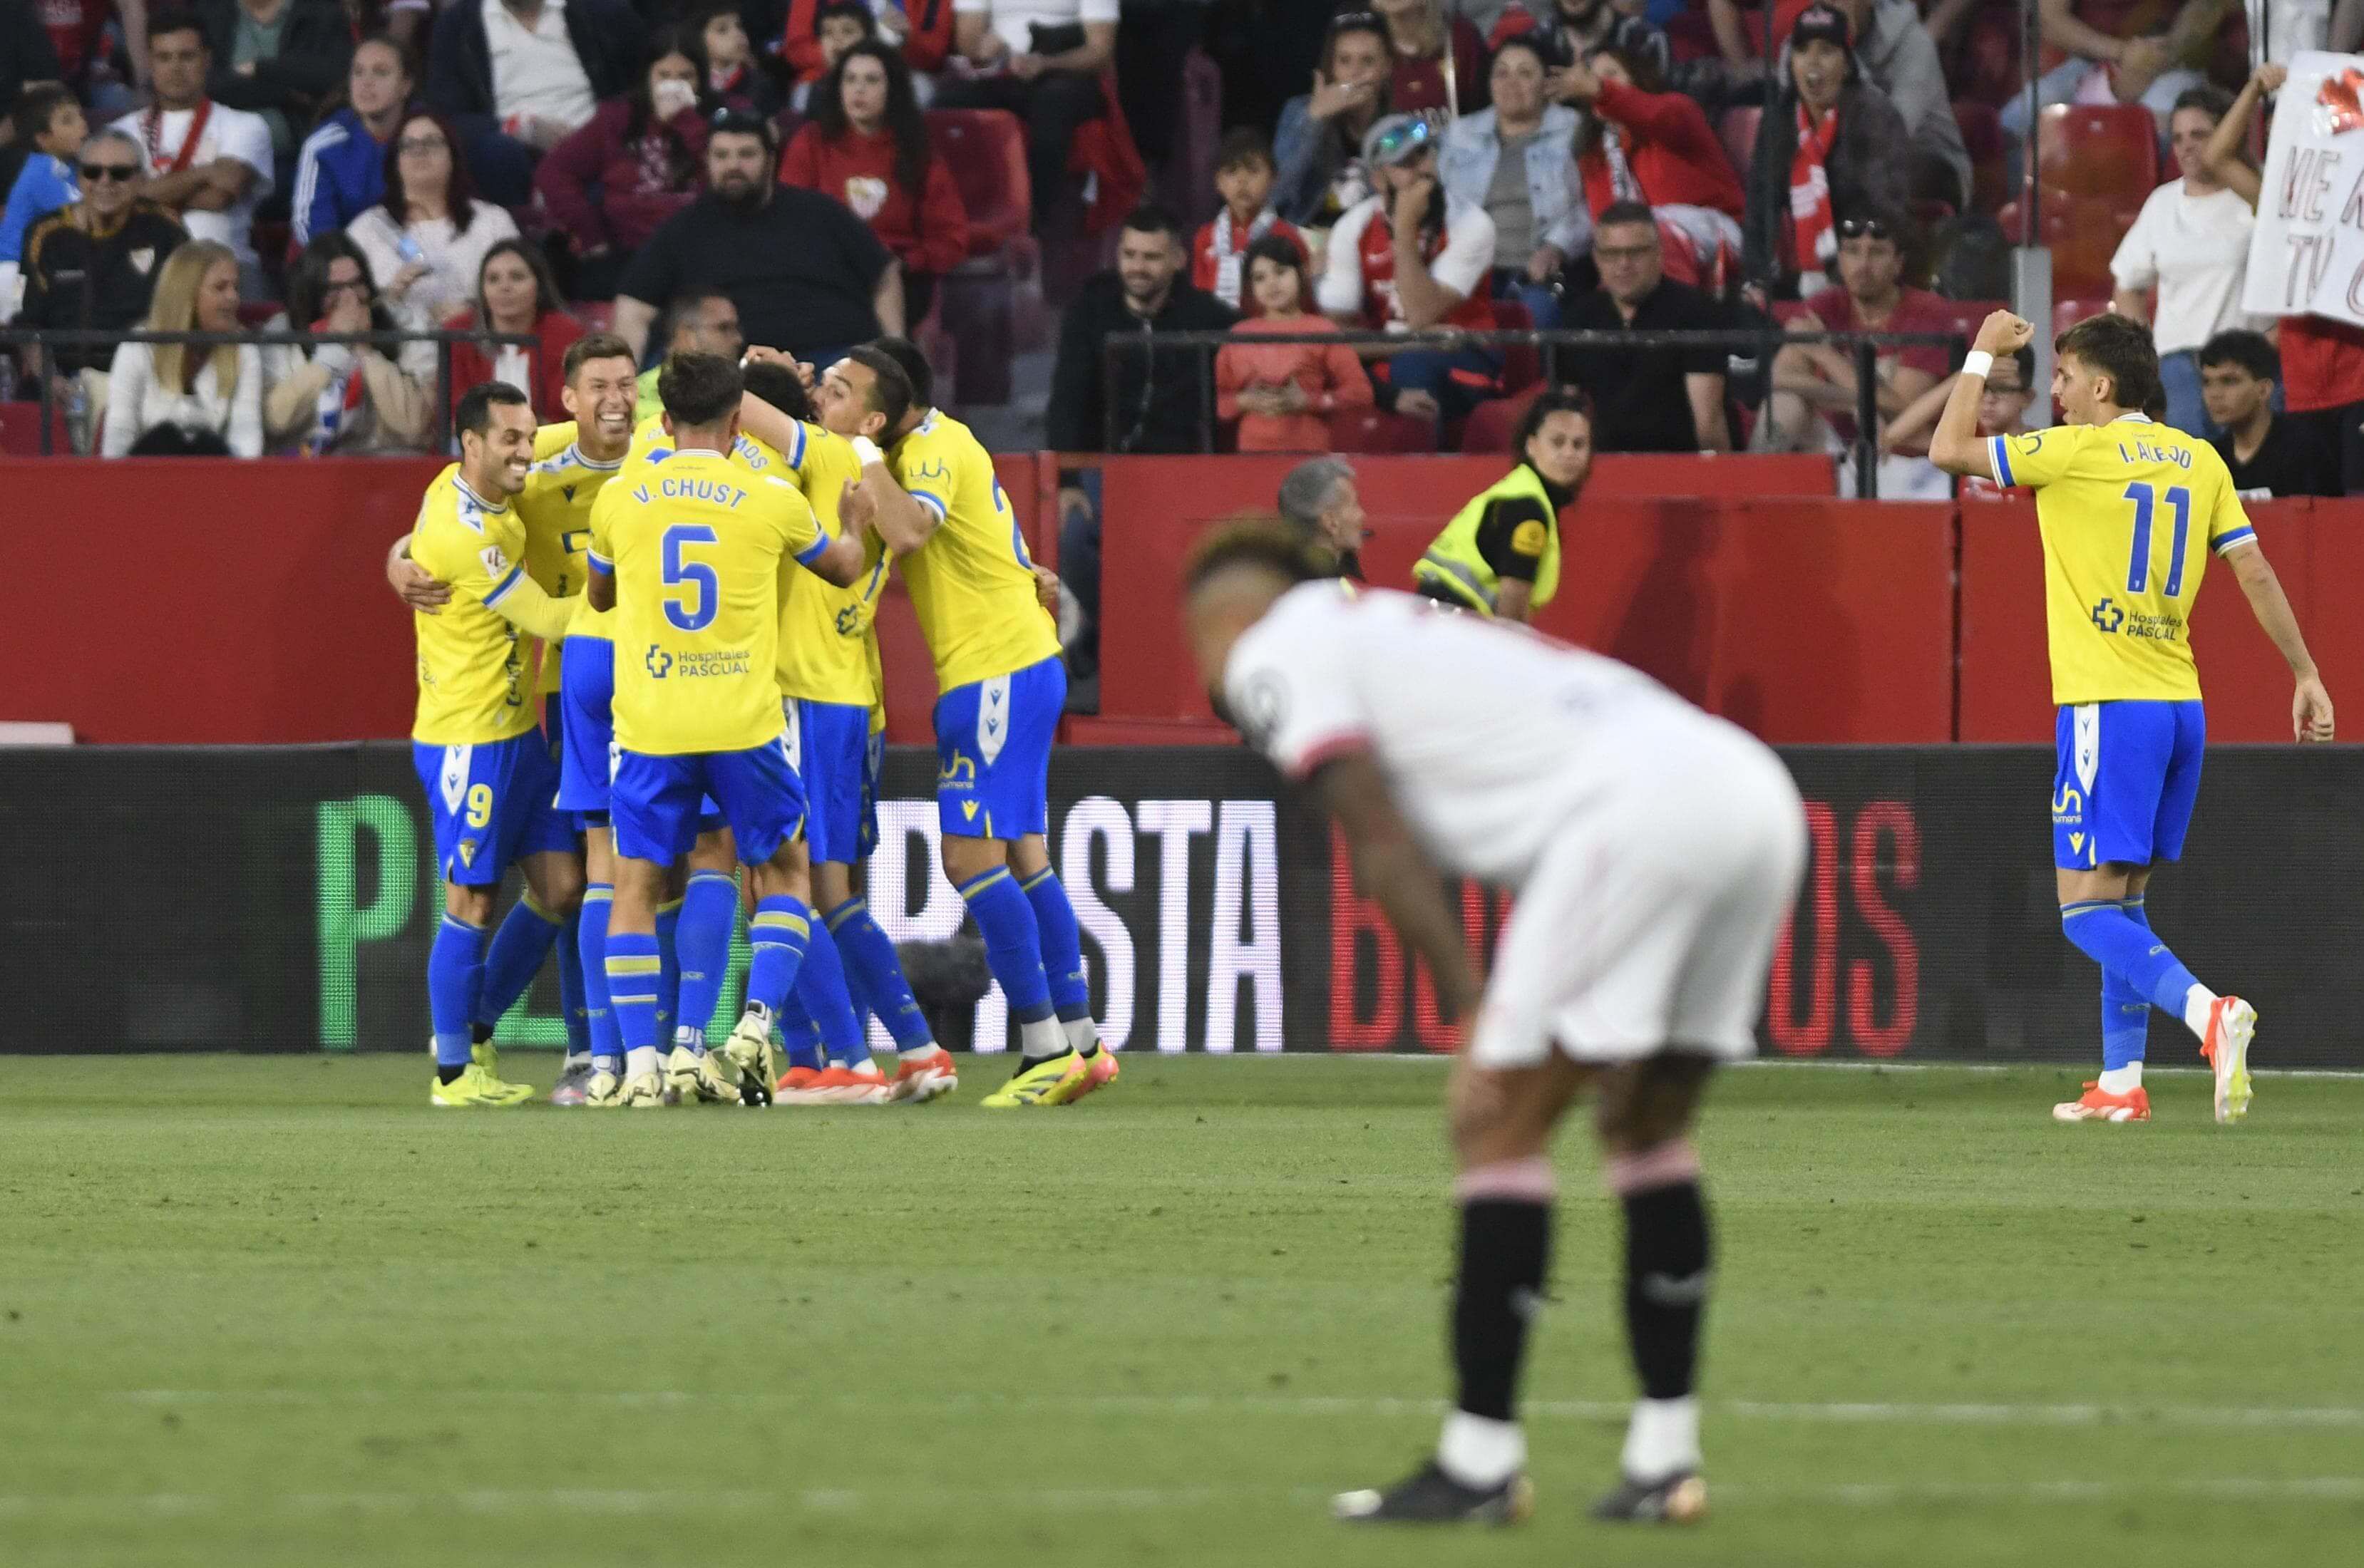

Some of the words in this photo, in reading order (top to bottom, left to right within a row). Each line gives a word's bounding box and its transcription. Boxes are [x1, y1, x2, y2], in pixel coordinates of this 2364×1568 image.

[734, 435, 768, 468] MOS
[2136, 441, 2191, 469] ALEJO
[633, 484, 657, 503] V.
[662, 478, 747, 507] CHUST
[2123, 482, 2191, 597] 11
[662, 524, 719, 631] 5
[2127, 625, 2176, 641] PASCAL
[2129, 610, 2182, 627] Hospales
[679, 649, 750, 664] Hospitales
[679, 661, 749, 676] PASCUAL
[466, 783, 493, 829] 9
[867, 796, 1283, 1054] PSTA
